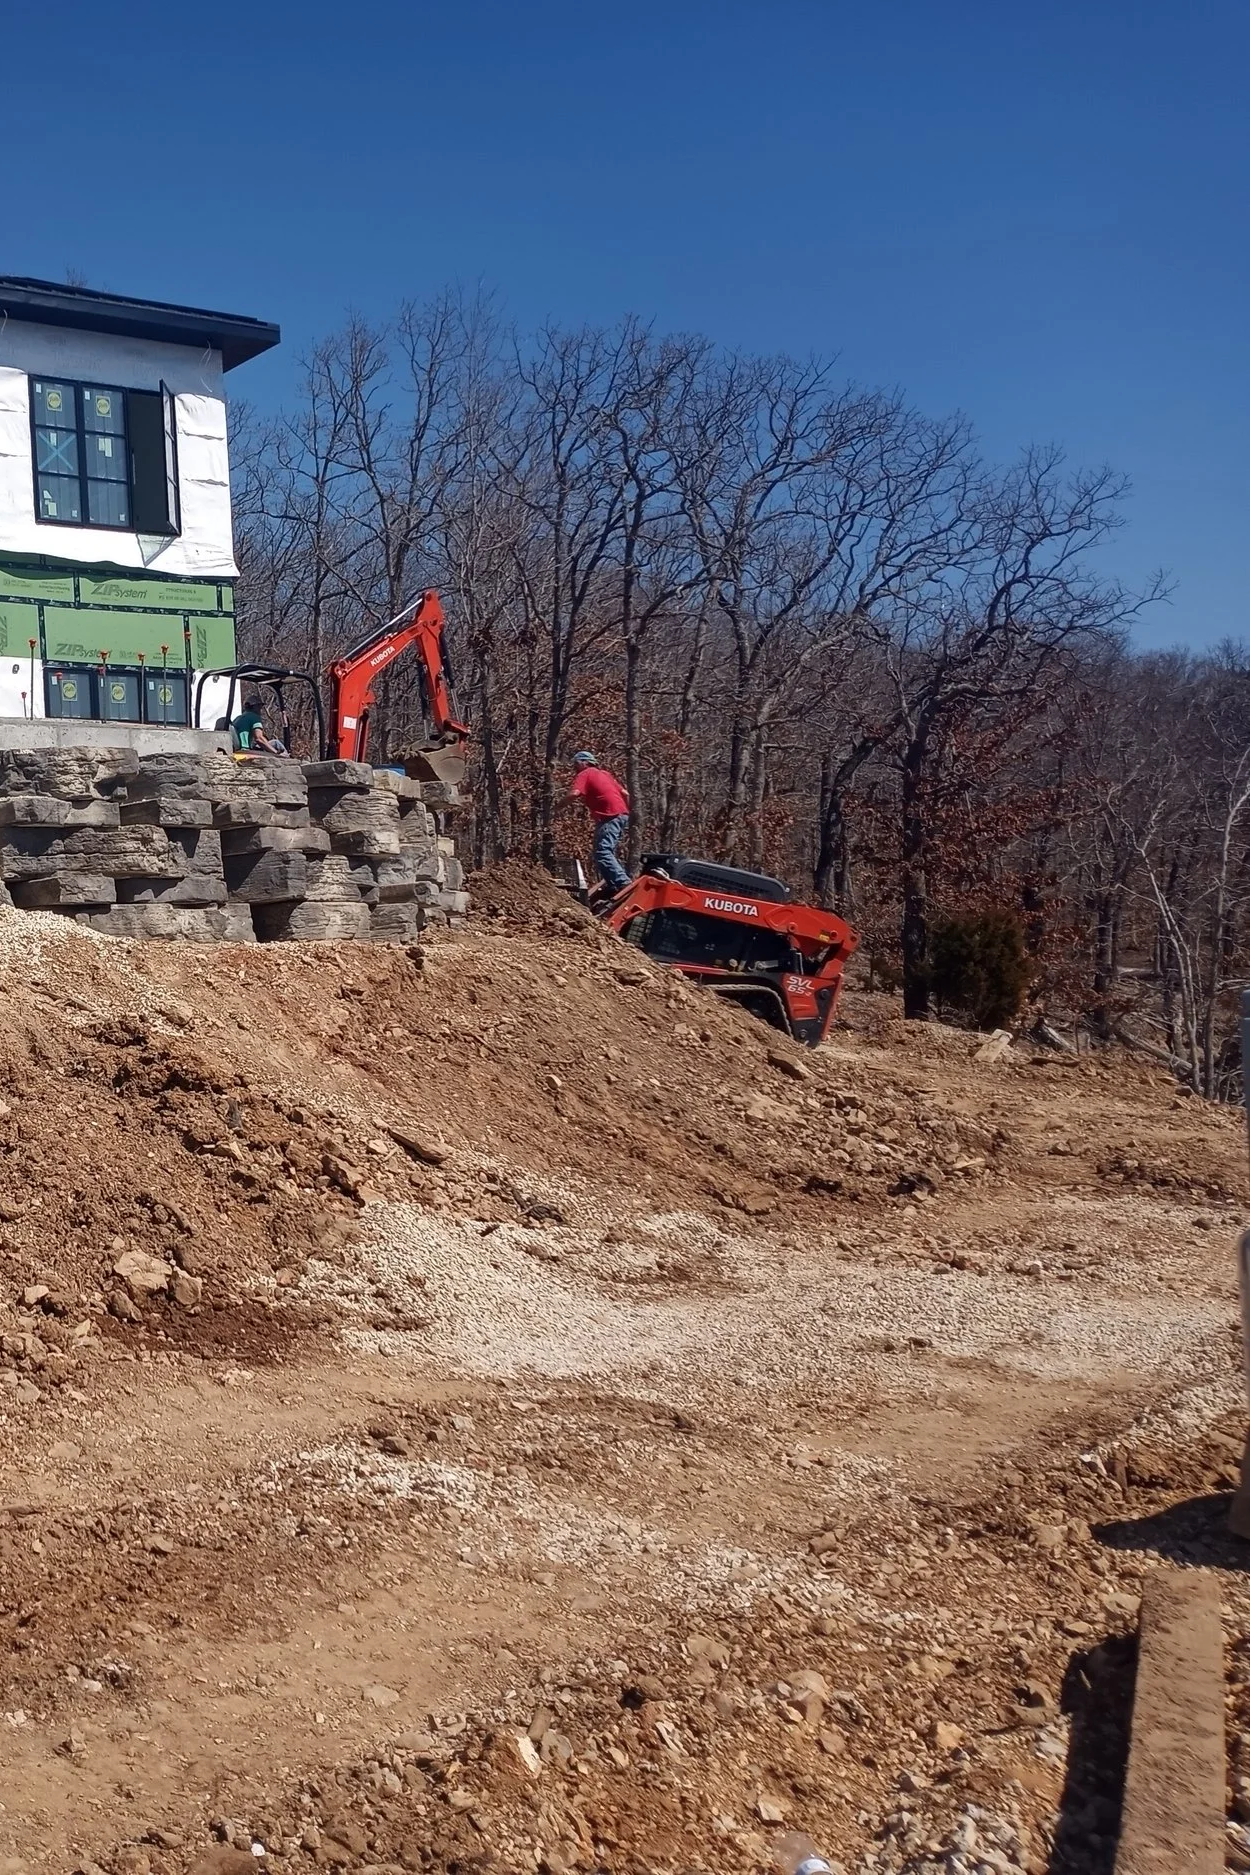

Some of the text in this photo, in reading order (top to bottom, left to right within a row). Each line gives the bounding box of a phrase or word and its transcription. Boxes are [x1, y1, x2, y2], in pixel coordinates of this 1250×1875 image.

[370, 646, 396, 667] KUBOTA
[704, 897, 759, 917] KUBOTA
[786, 975, 815, 990] SVL
